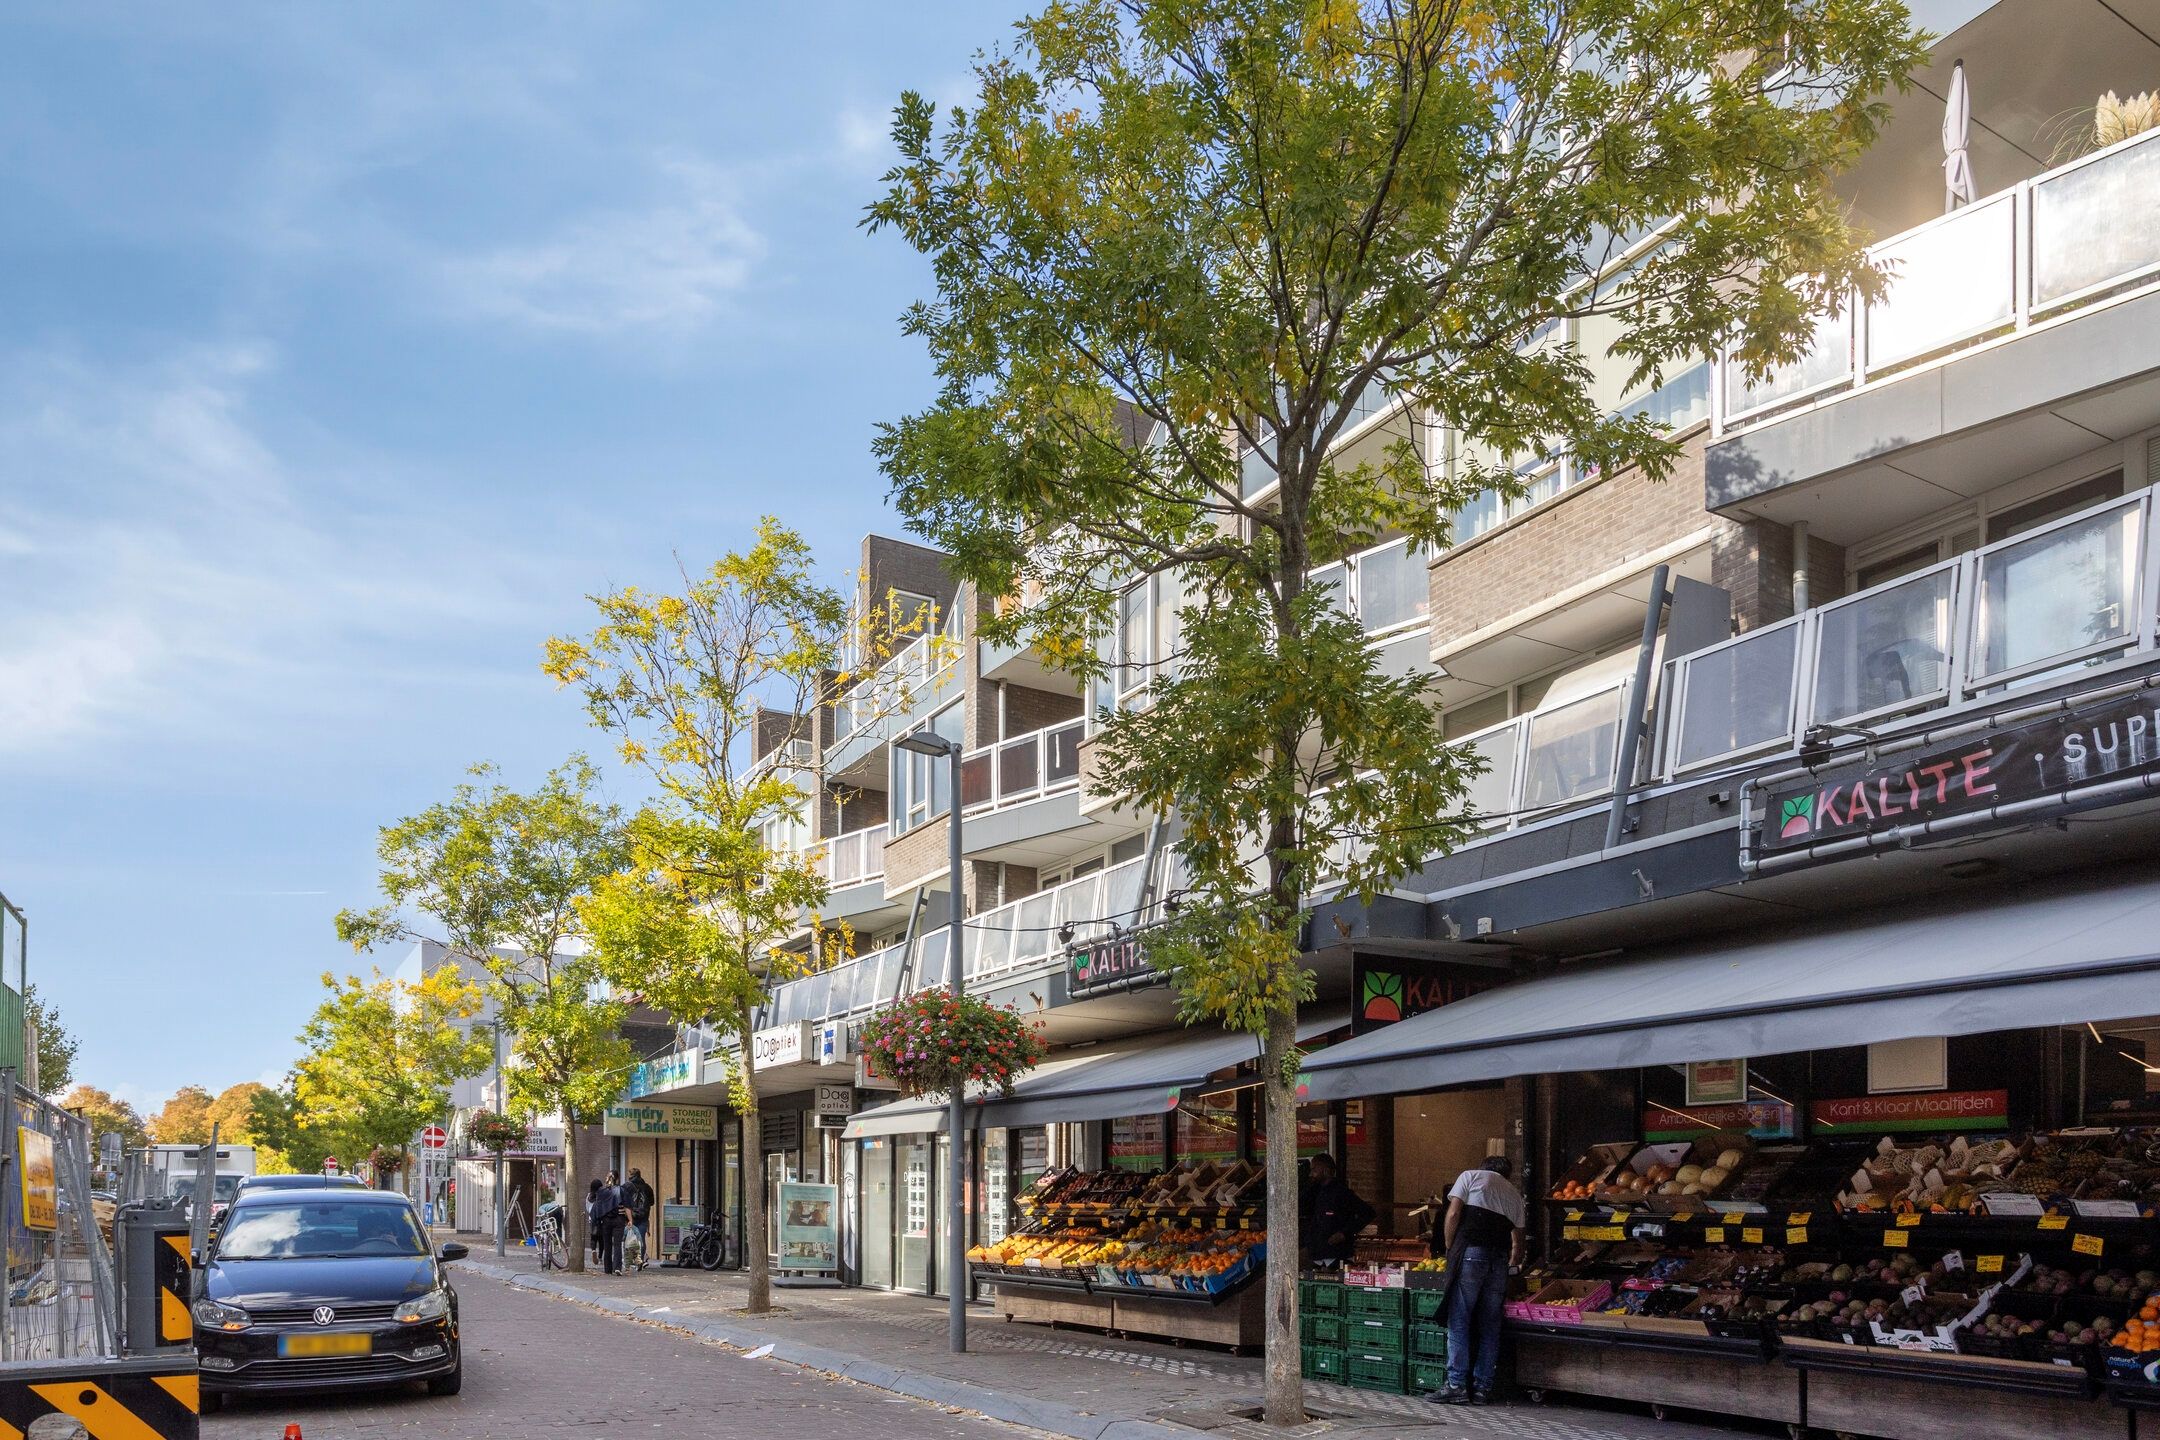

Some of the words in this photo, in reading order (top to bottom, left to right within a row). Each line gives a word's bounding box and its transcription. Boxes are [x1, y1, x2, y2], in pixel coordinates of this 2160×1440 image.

[1815, 748, 1997, 830] KALITE
[821, 1087, 849, 1103] Dag
[1914, 1096, 1994, 1113] Maaltijden
[607, 1106, 664, 1122] Laundry
[672, 1109, 712, 1117] STOMERIJ
[637, 1118, 669, 1133] Land
[672, 1117, 711, 1126] WASSERIJ
